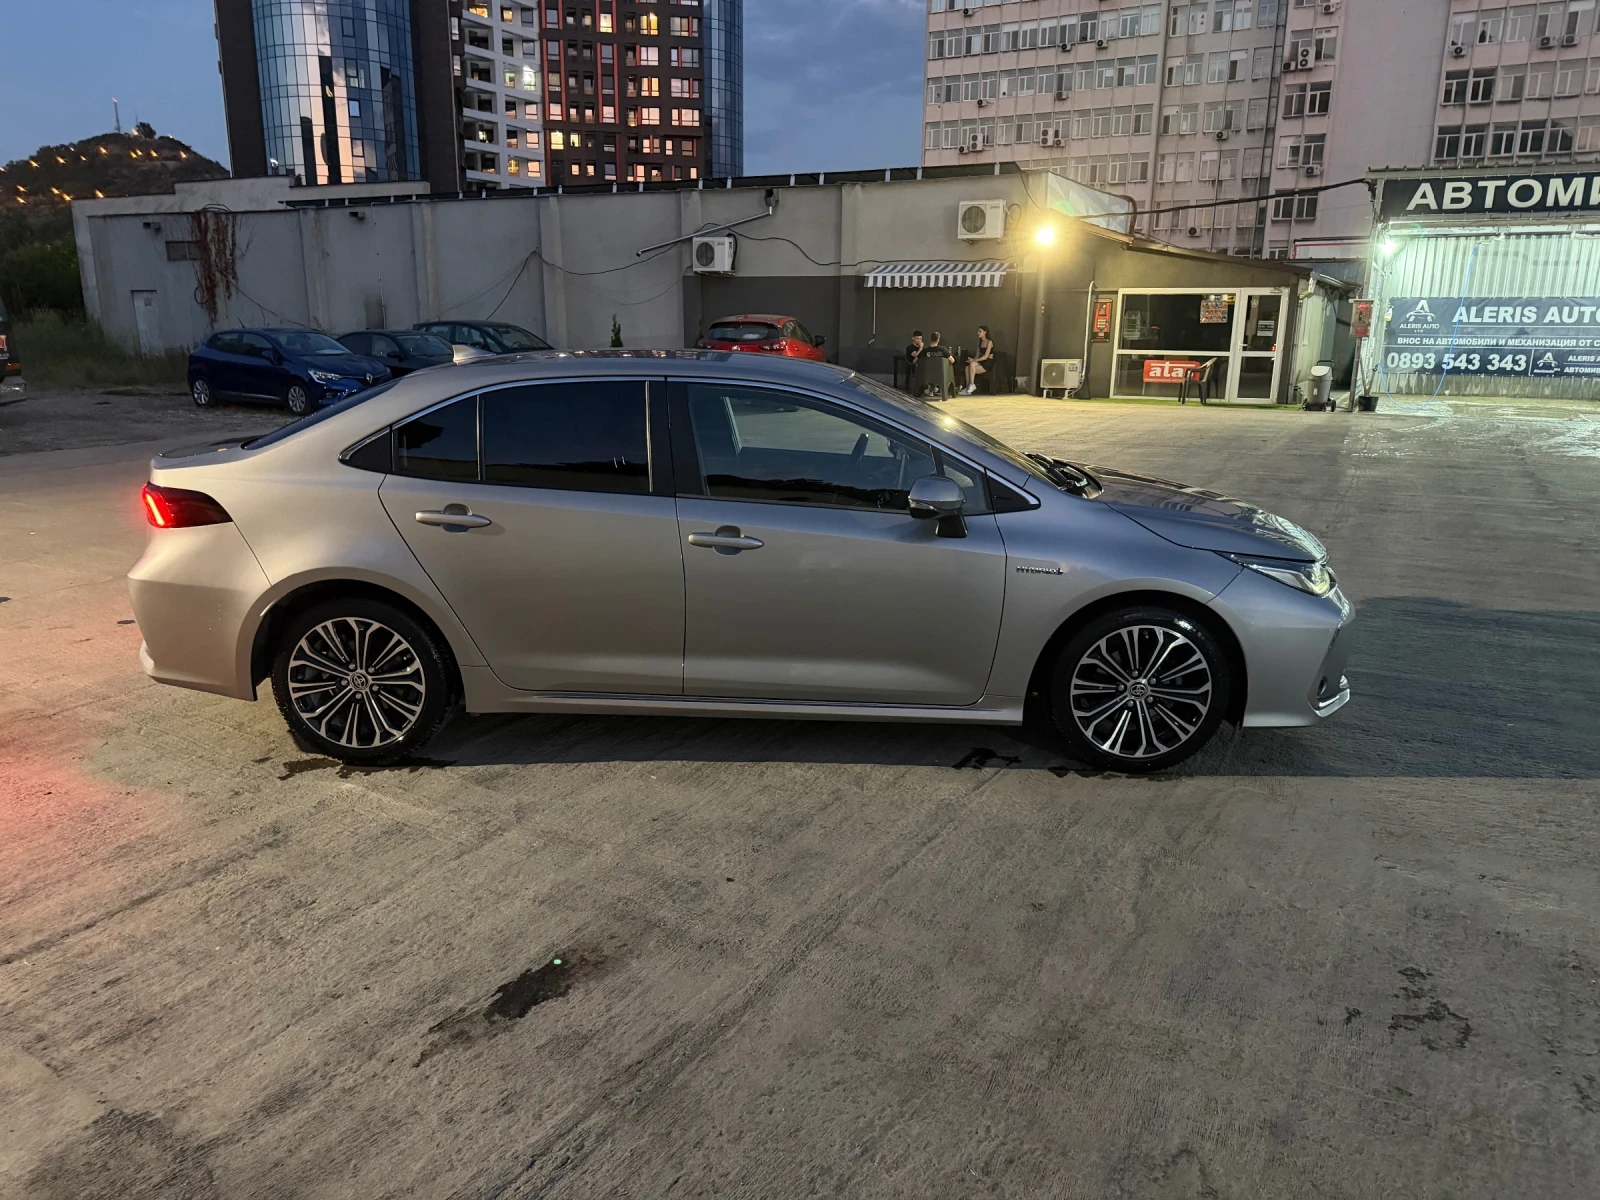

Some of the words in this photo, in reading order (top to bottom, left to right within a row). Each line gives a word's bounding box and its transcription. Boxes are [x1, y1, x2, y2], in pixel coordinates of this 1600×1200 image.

[1452, 306, 1538, 323] ALERIS
[1543, 306, 1600, 323] AUT
[1397, 337, 1421, 345] ВНОС
[1436, 338, 1496, 346] АВТОМОБИЛИ
[1507, 339, 1577, 348] МЕХАНИЗАЦИЯ
[1578, 339, 1593, 347] ОТ
[1149, 361, 1193, 378] ata
[1386, 352, 1436, 369] 0893
[1441, 353, 1480, 370] 543
[1486, 353, 1527, 371] 343
